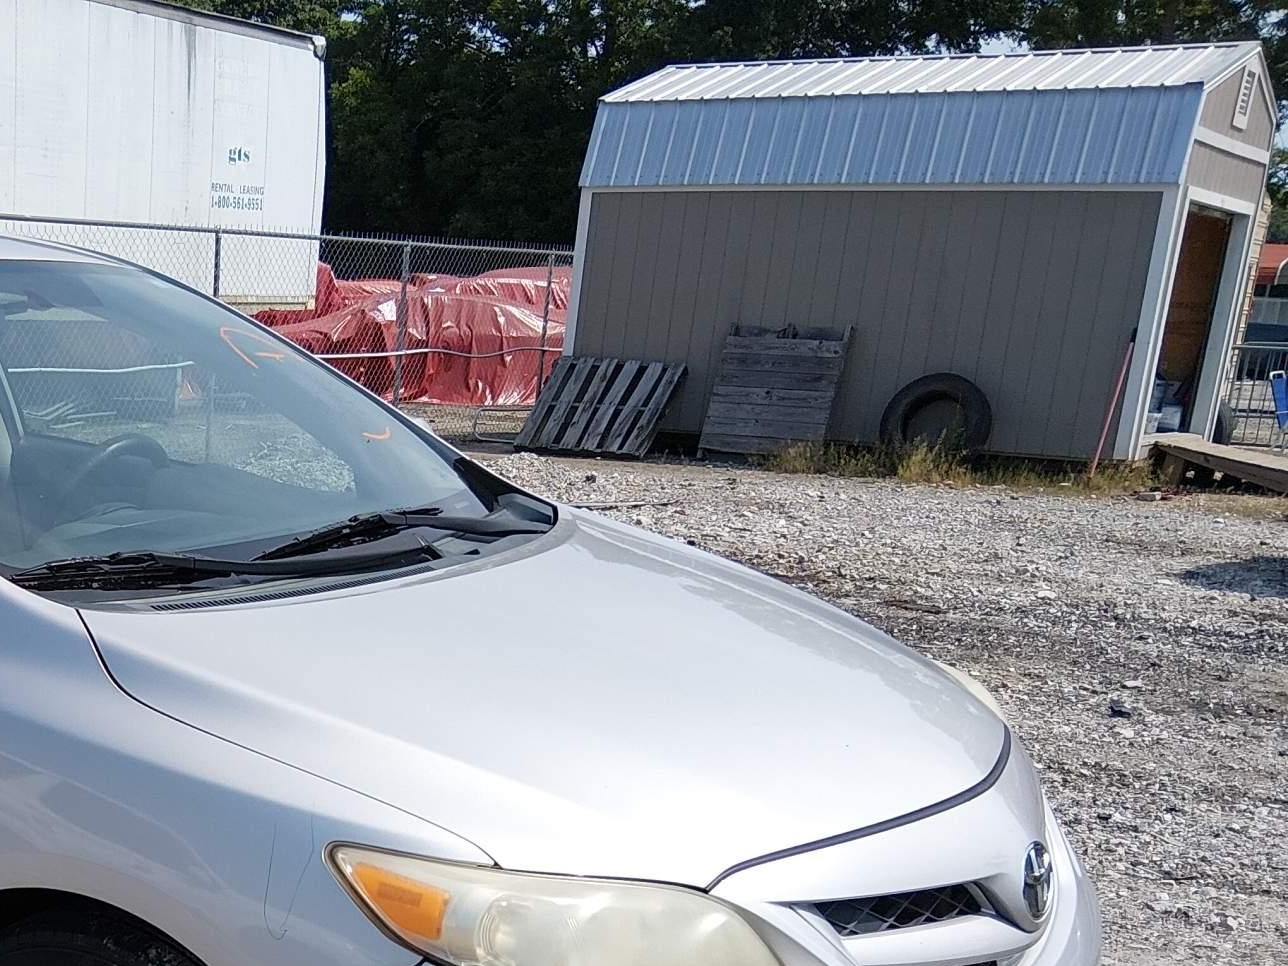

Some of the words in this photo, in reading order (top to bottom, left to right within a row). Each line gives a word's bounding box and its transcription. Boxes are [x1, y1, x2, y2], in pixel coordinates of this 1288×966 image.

[228, 147, 250, 165] gts
[211, 182, 234, 194] RENTAL
[239, 185, 264, 196] LEASING
